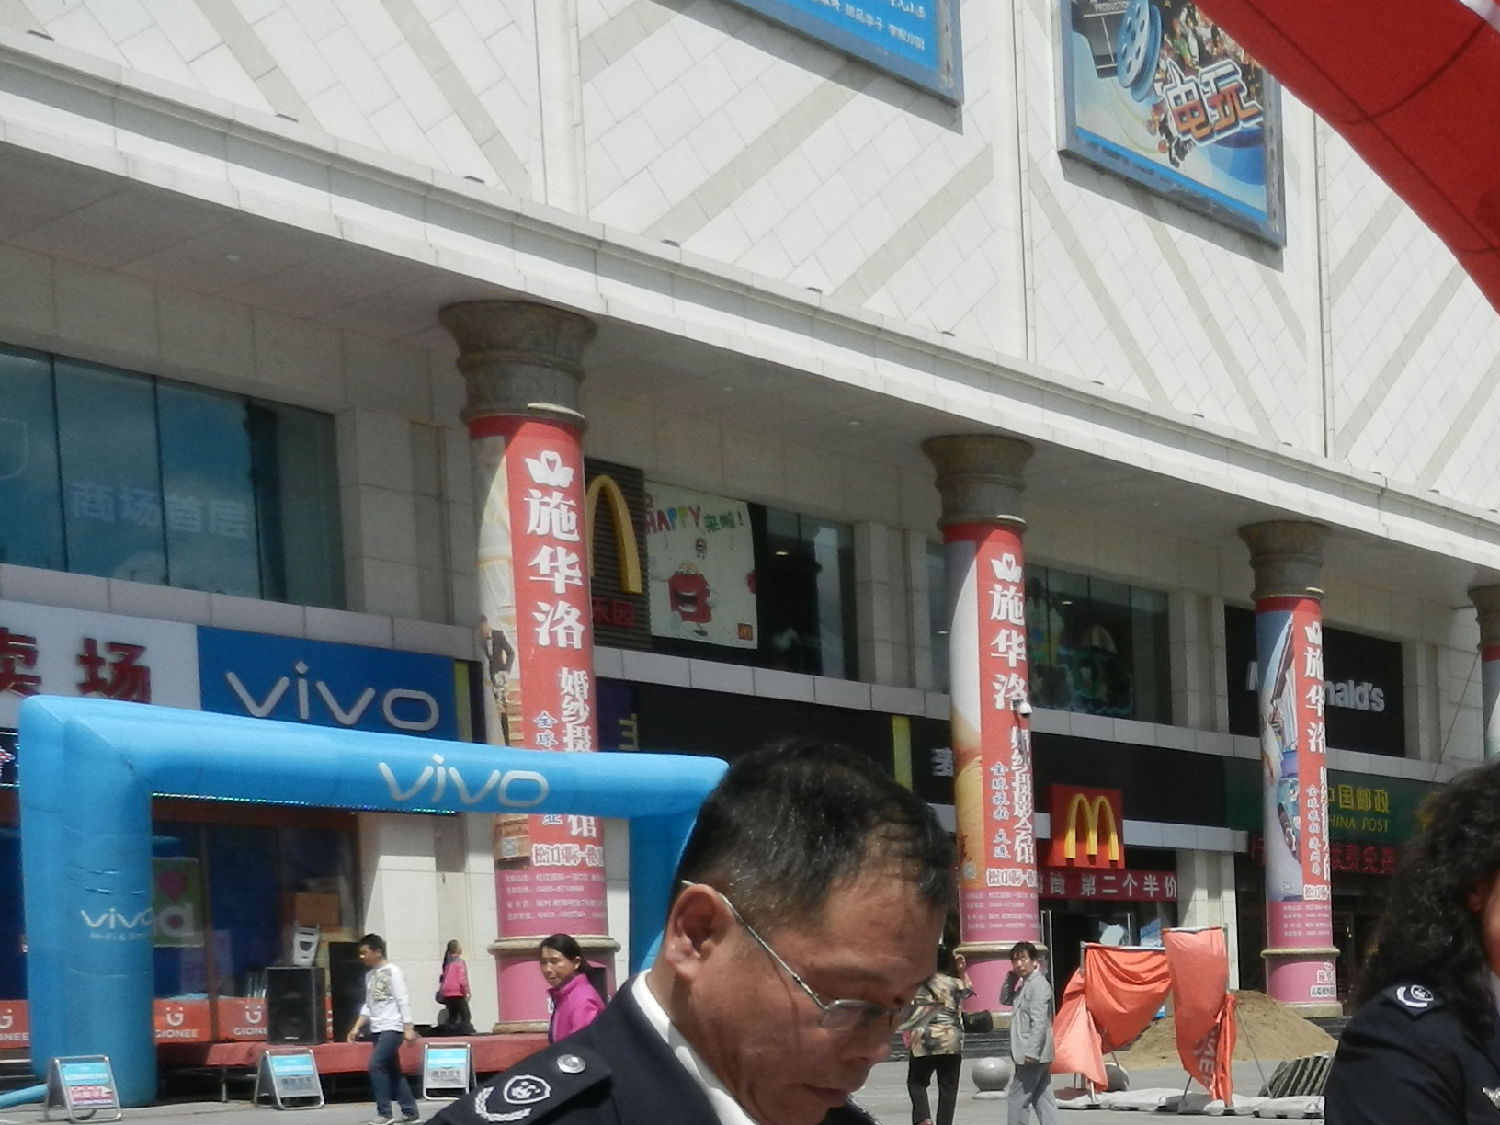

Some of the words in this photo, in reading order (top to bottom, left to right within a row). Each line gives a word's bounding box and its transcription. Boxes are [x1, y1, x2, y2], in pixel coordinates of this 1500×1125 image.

[1163, 59, 1263, 146] 电玩
[645, 504, 701, 533] HAPPY
[524, 488, 586, 650] 施华洛
[0, 627, 151, 702] 卖场
[988, 583, 1028, 711] 施华洛
[225, 661, 440, 731] vivo
[1303, 646, 1327, 754] 施华洛
[378, 754, 549, 808] vivo
[1330, 817, 1357, 831] HINA
[1362, 818, 1390, 834] POST
[1081, 871, 1177, 898] 第二个半价
[232, 1026, 267, 1036] GION
